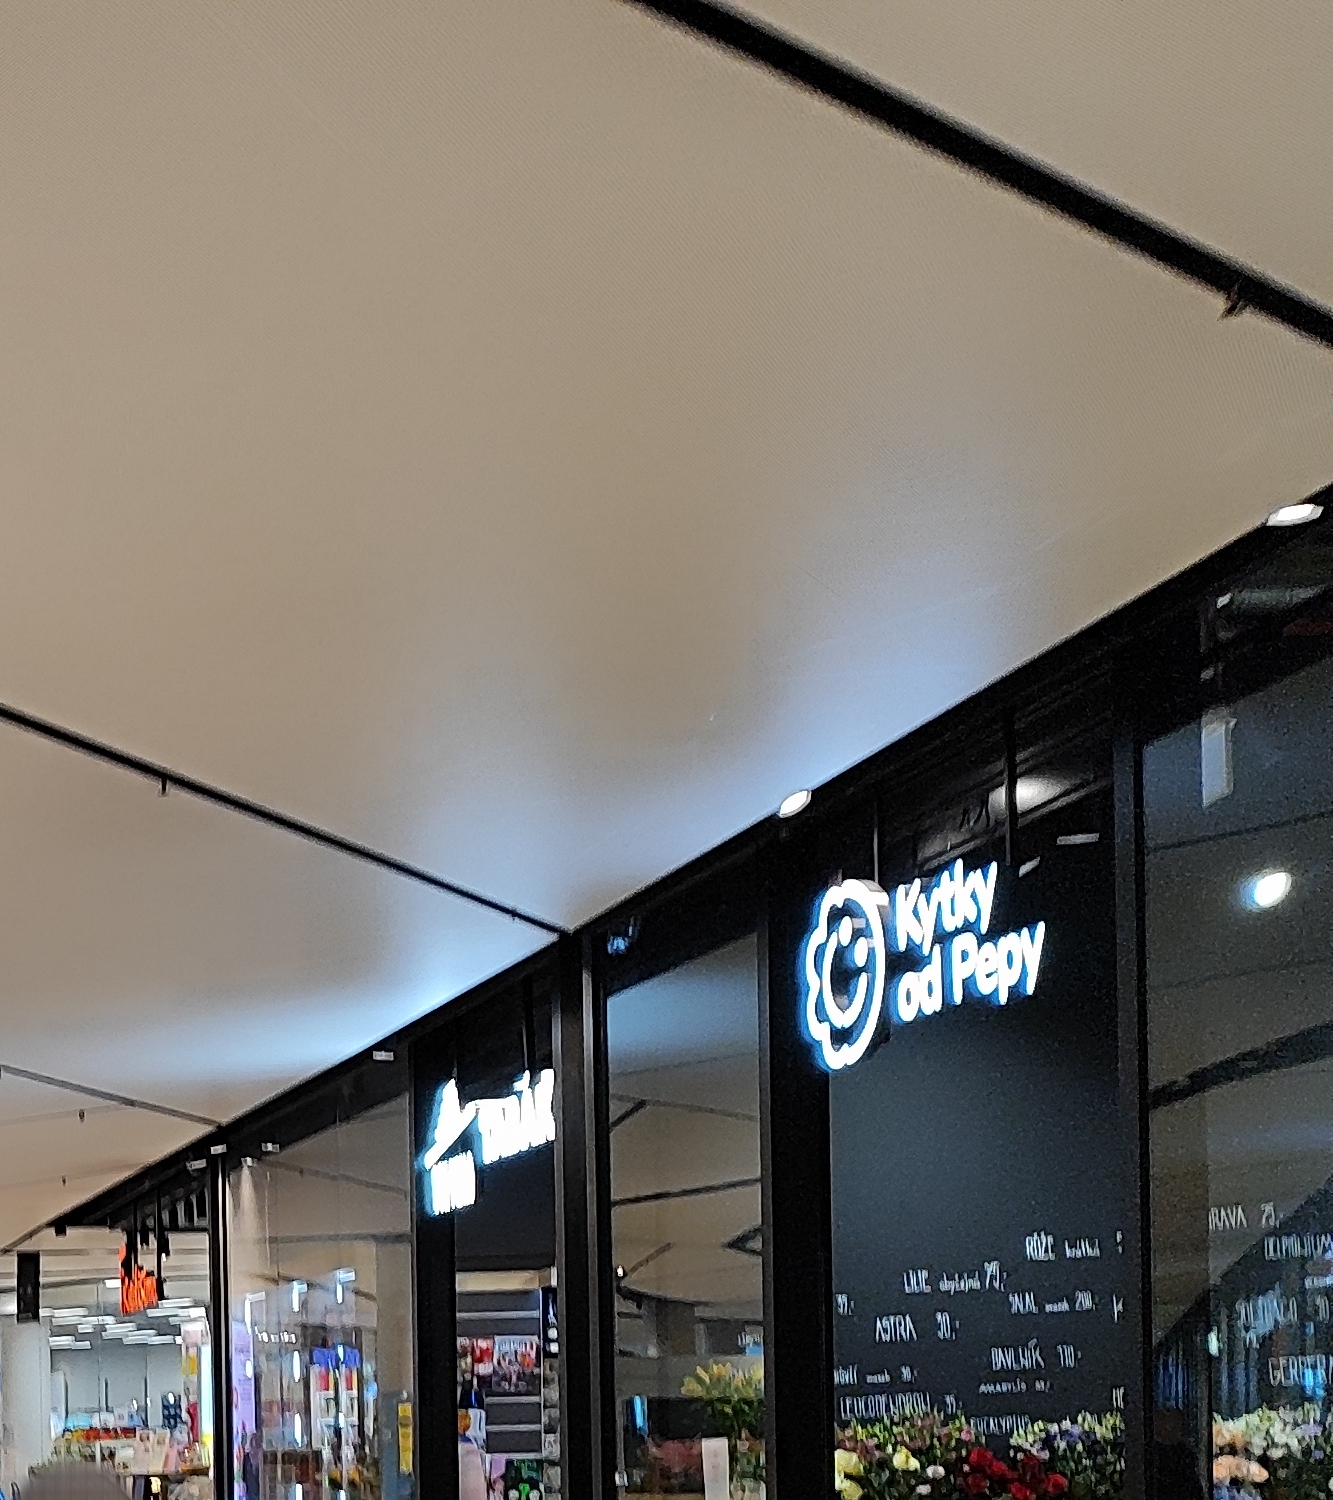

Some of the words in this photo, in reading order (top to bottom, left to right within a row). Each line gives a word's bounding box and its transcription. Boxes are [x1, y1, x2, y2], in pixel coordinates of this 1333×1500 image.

[896, 858, 998, 956] Kytky
[897, 943, 944, 1022] od
[952, 921, 1045, 1006] Pepy
[875, 1313, 919, 1343] ASTRA
